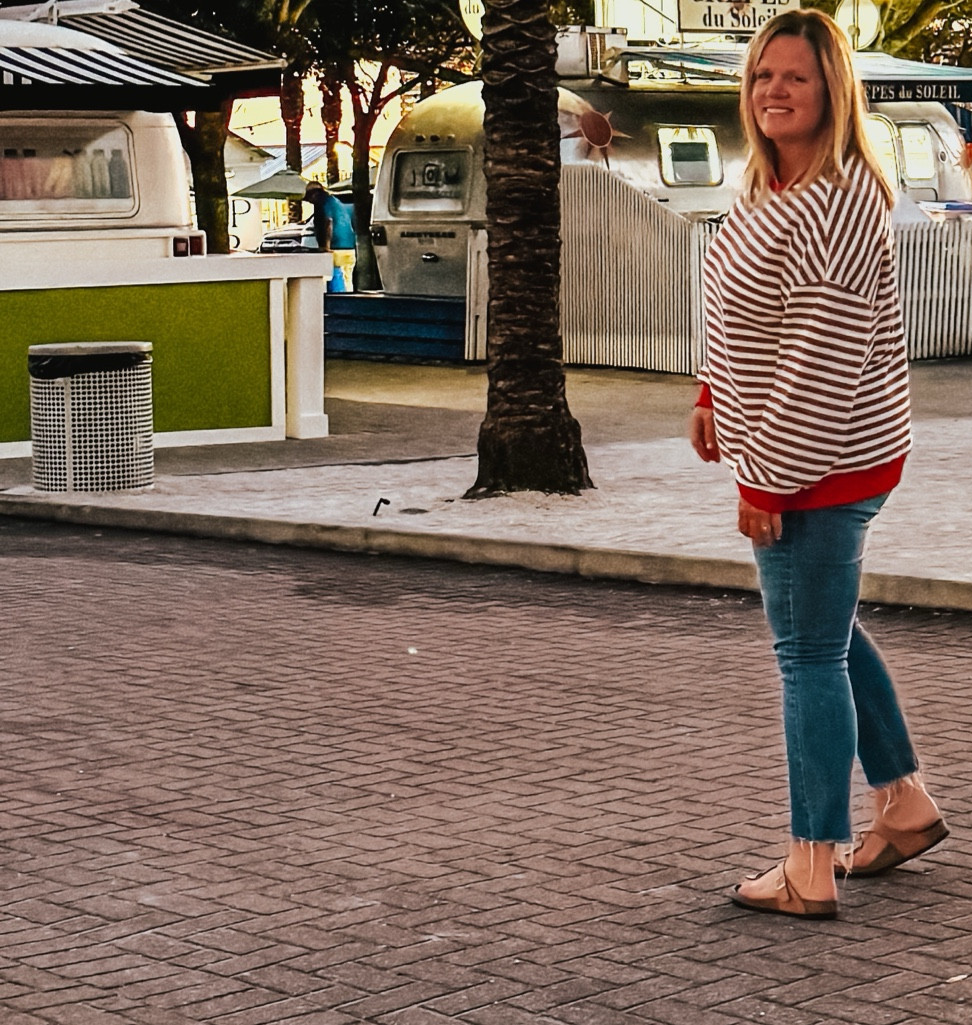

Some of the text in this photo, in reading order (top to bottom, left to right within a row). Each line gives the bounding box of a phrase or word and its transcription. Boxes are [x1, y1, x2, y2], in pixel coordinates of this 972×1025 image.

[703, 5, 724, 27] du
[899, 85, 912, 99] du
[916, 85, 961, 99] SOLEIL
